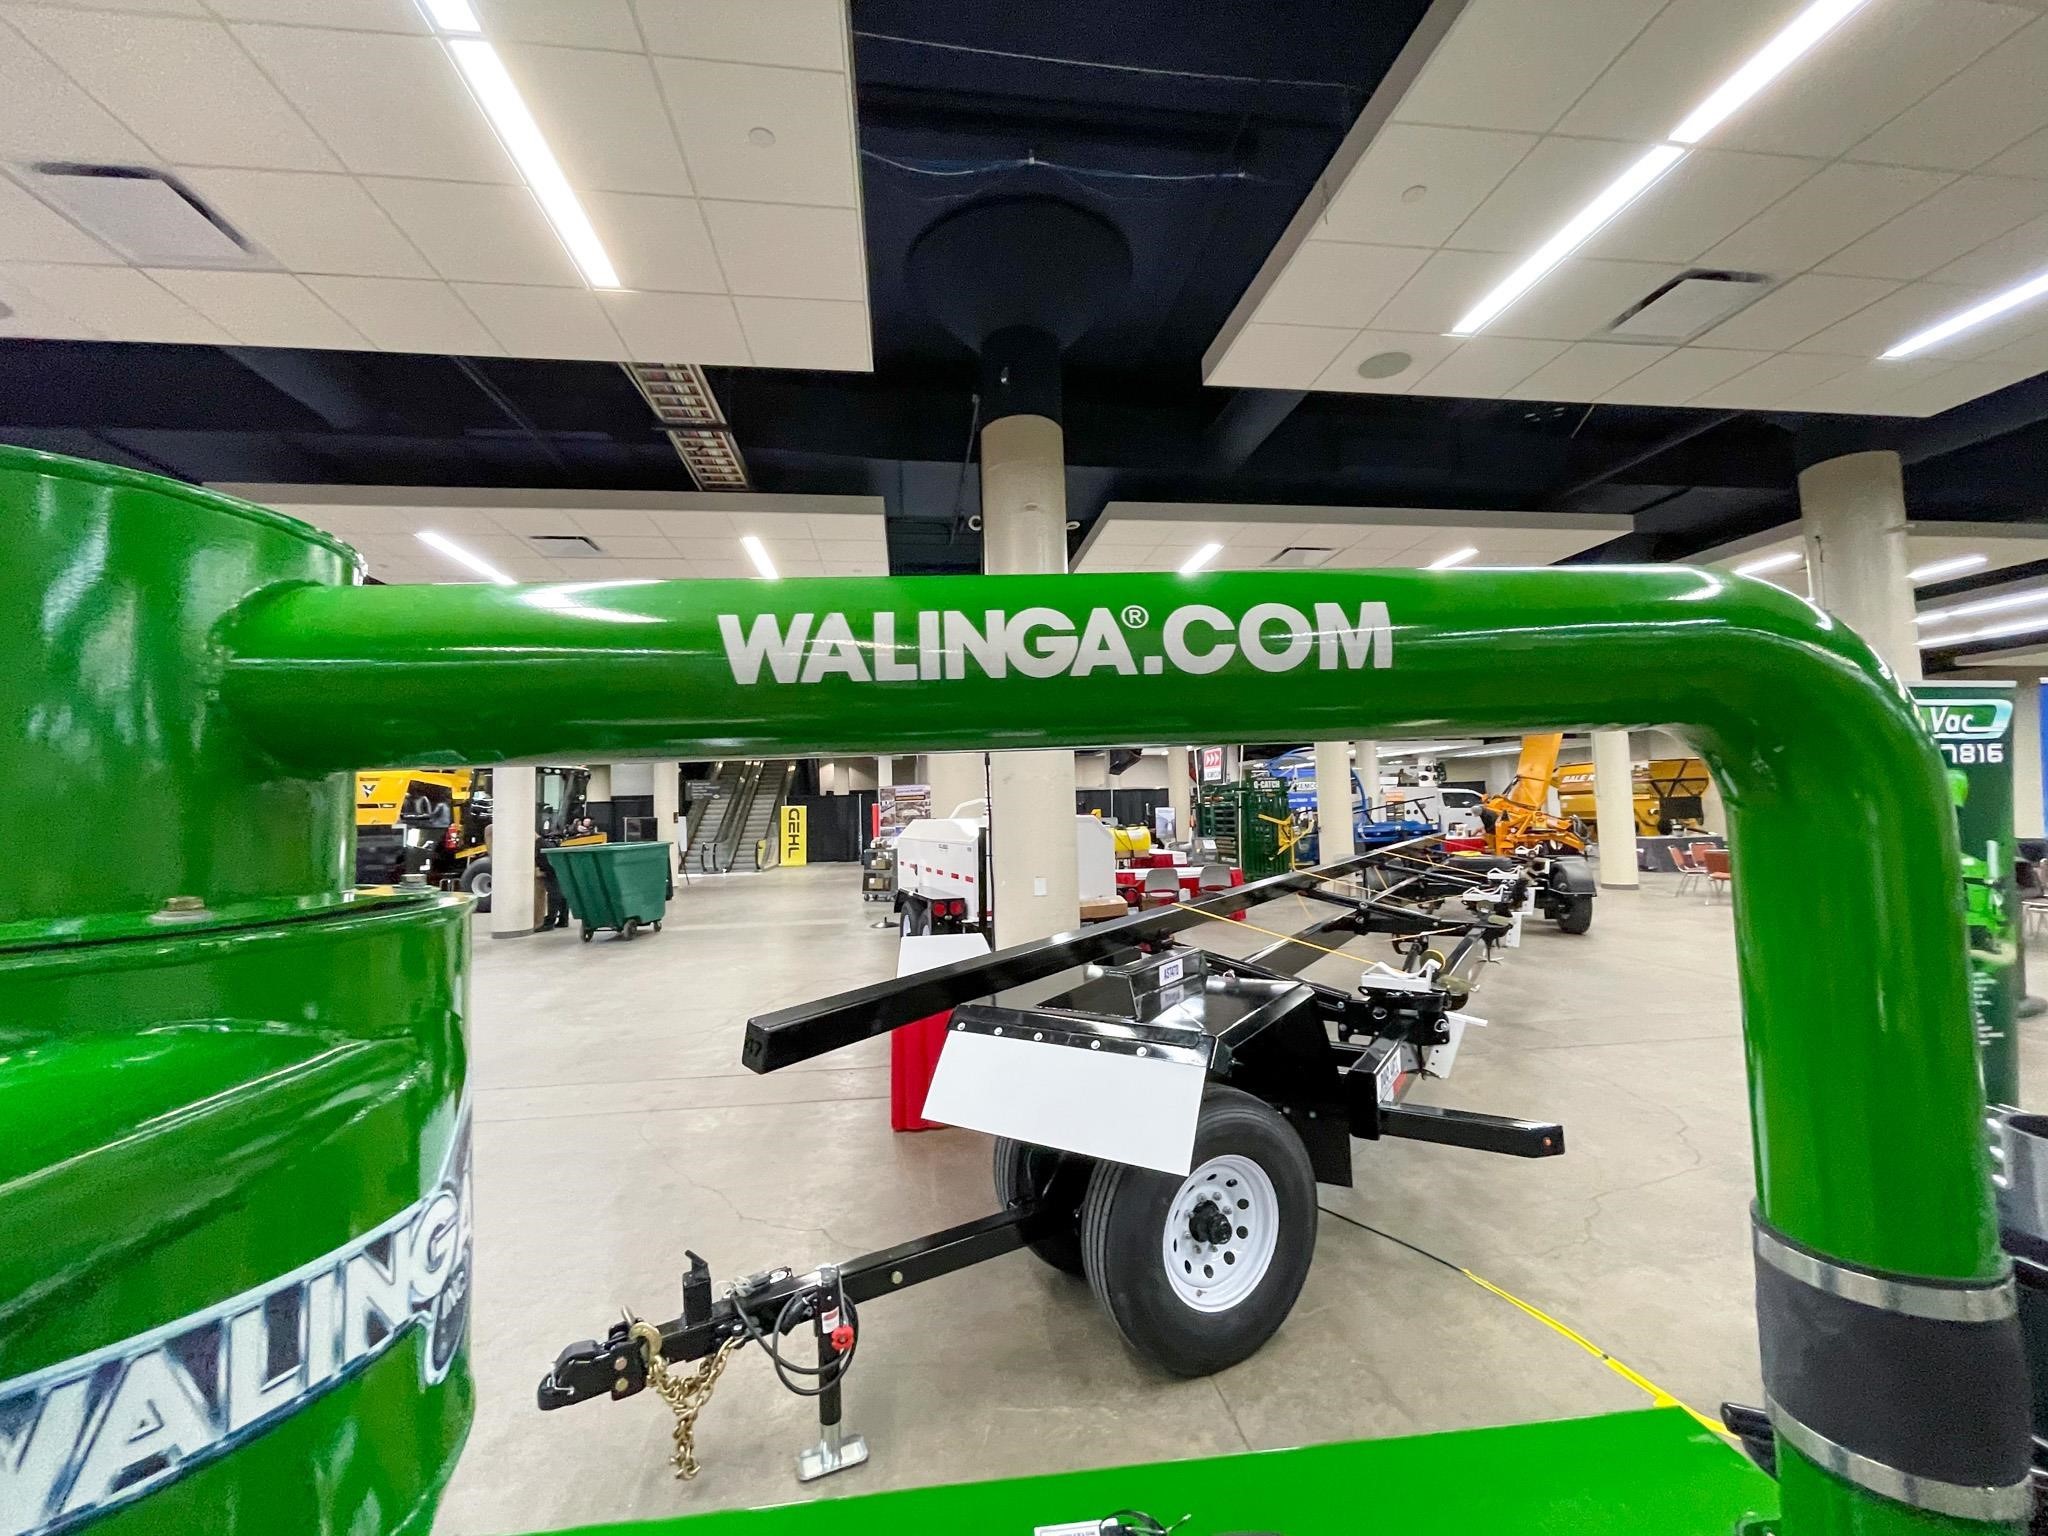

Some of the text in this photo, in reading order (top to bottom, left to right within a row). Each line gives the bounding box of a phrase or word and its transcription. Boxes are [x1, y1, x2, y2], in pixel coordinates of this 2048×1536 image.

[1929, 706, 1976, 733] Vac
[1940, 743, 2004, 764] 7816
[788, 808, 800, 859] GEHL
